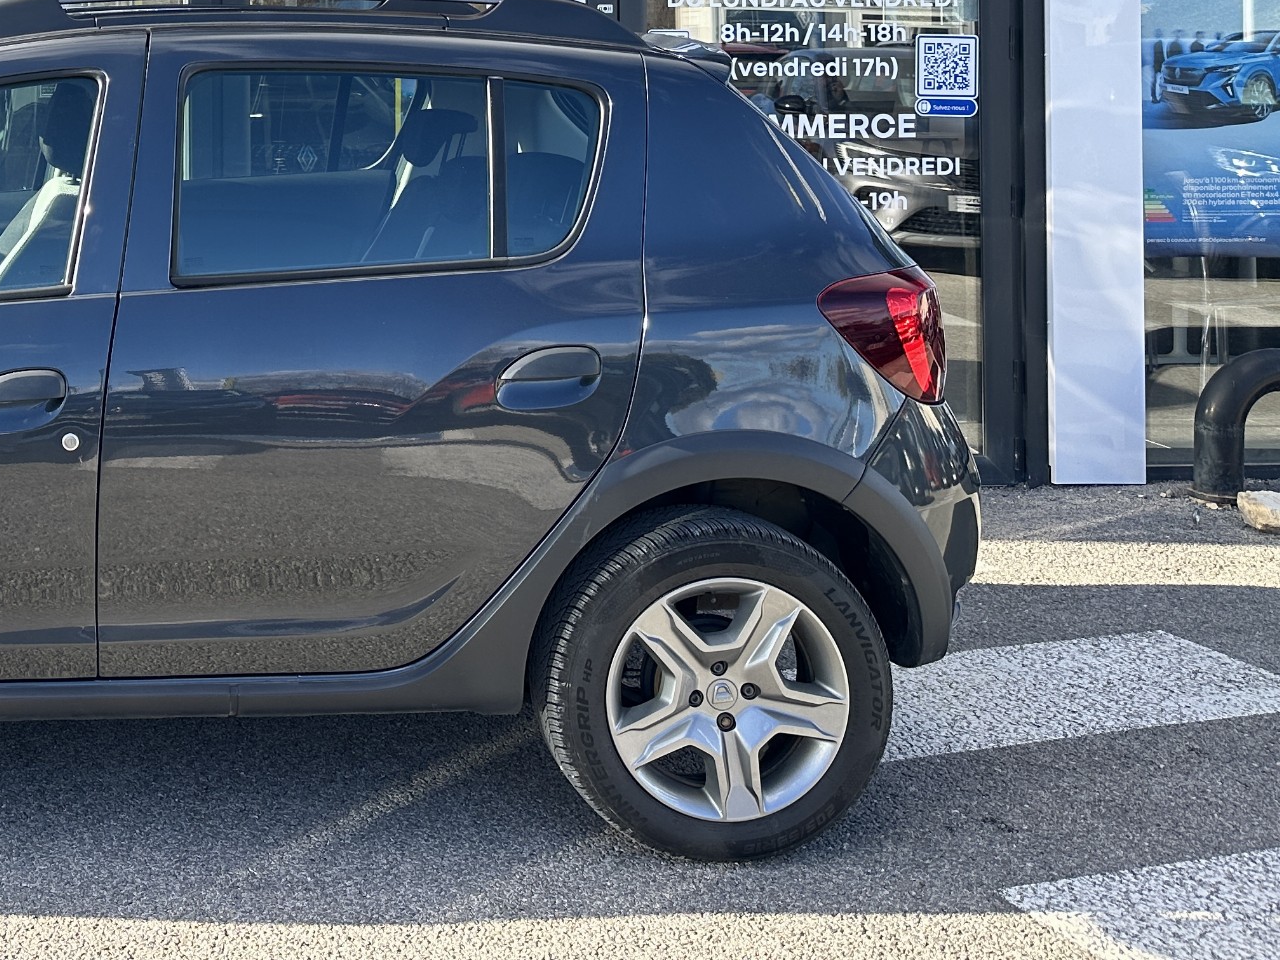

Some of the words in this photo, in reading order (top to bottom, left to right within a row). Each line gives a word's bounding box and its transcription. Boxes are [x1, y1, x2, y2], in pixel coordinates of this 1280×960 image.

[721, 23, 800, 43] 8h-12h
[803, 23, 815, 46] /
[819, 23, 907, 43] 14h-18h
[730, 57, 848, 80] (vendredi
[853, 57, 899, 80] 17h)
[833, 157, 961, 176] VENDREDI
[1183, 177, 1210, 185] jusqu'à
[1183, 184, 1221, 192] disponible
[1222, 184, 1277, 192] prochainement
[1208, 199, 1234, 207] hybride
[823, 586, 887, 733] LANVIGATOR
